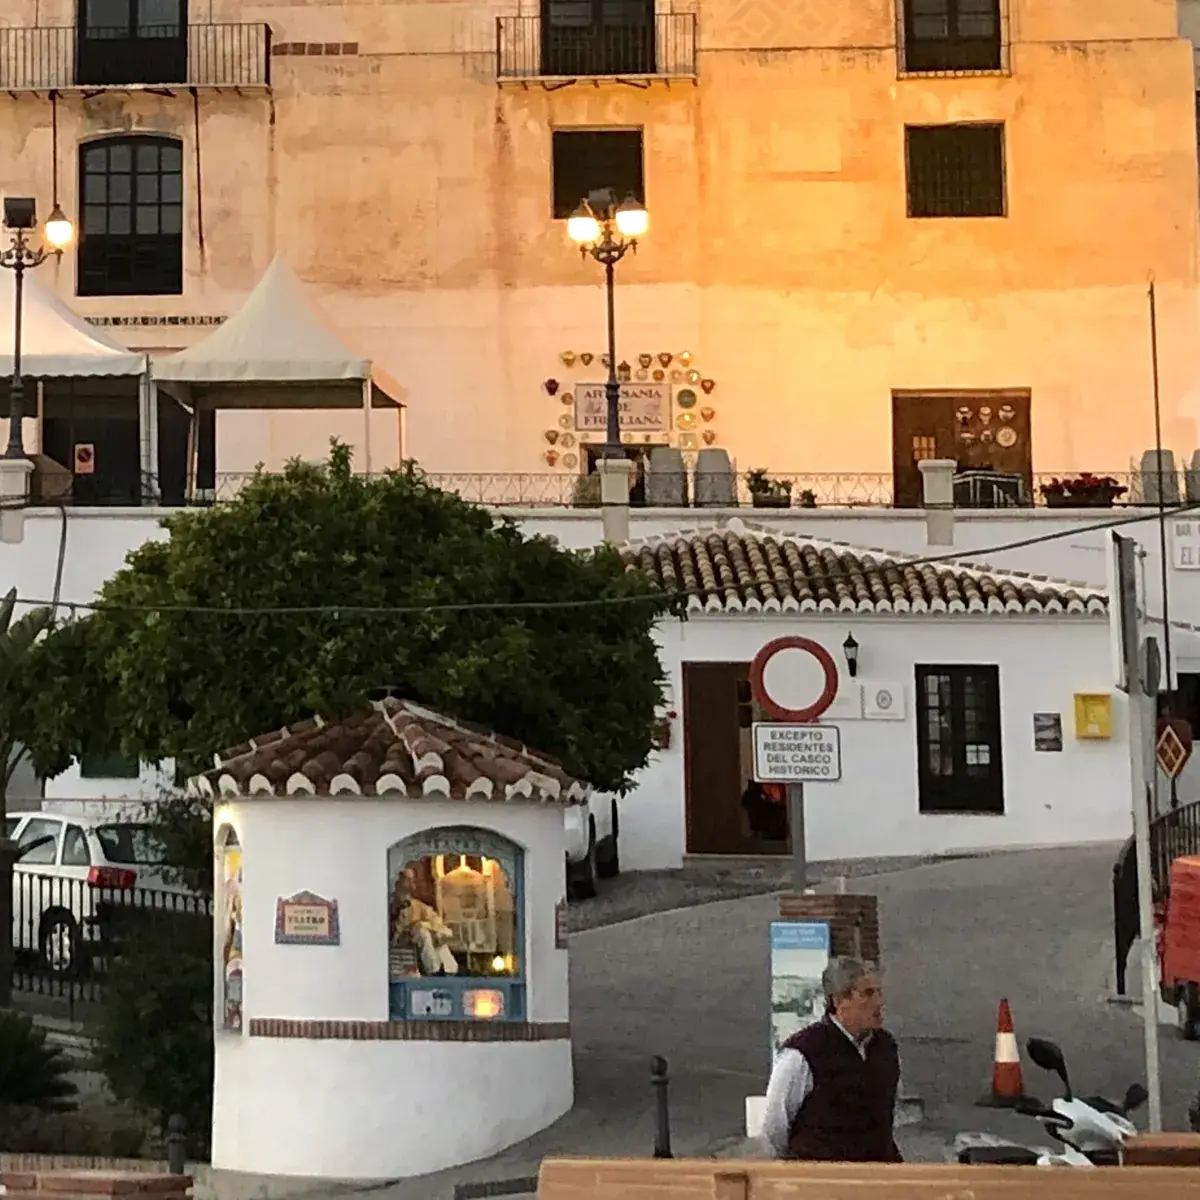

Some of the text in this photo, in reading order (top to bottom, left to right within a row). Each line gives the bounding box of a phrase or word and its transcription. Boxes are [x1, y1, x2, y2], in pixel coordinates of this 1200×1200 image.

[770, 730, 823, 740] EXCEPTO
[763, 742, 834, 752] RESIDENTES
[766, 753, 831, 764] DEL CASCO
[768, 765, 830, 776] HISTORICO
